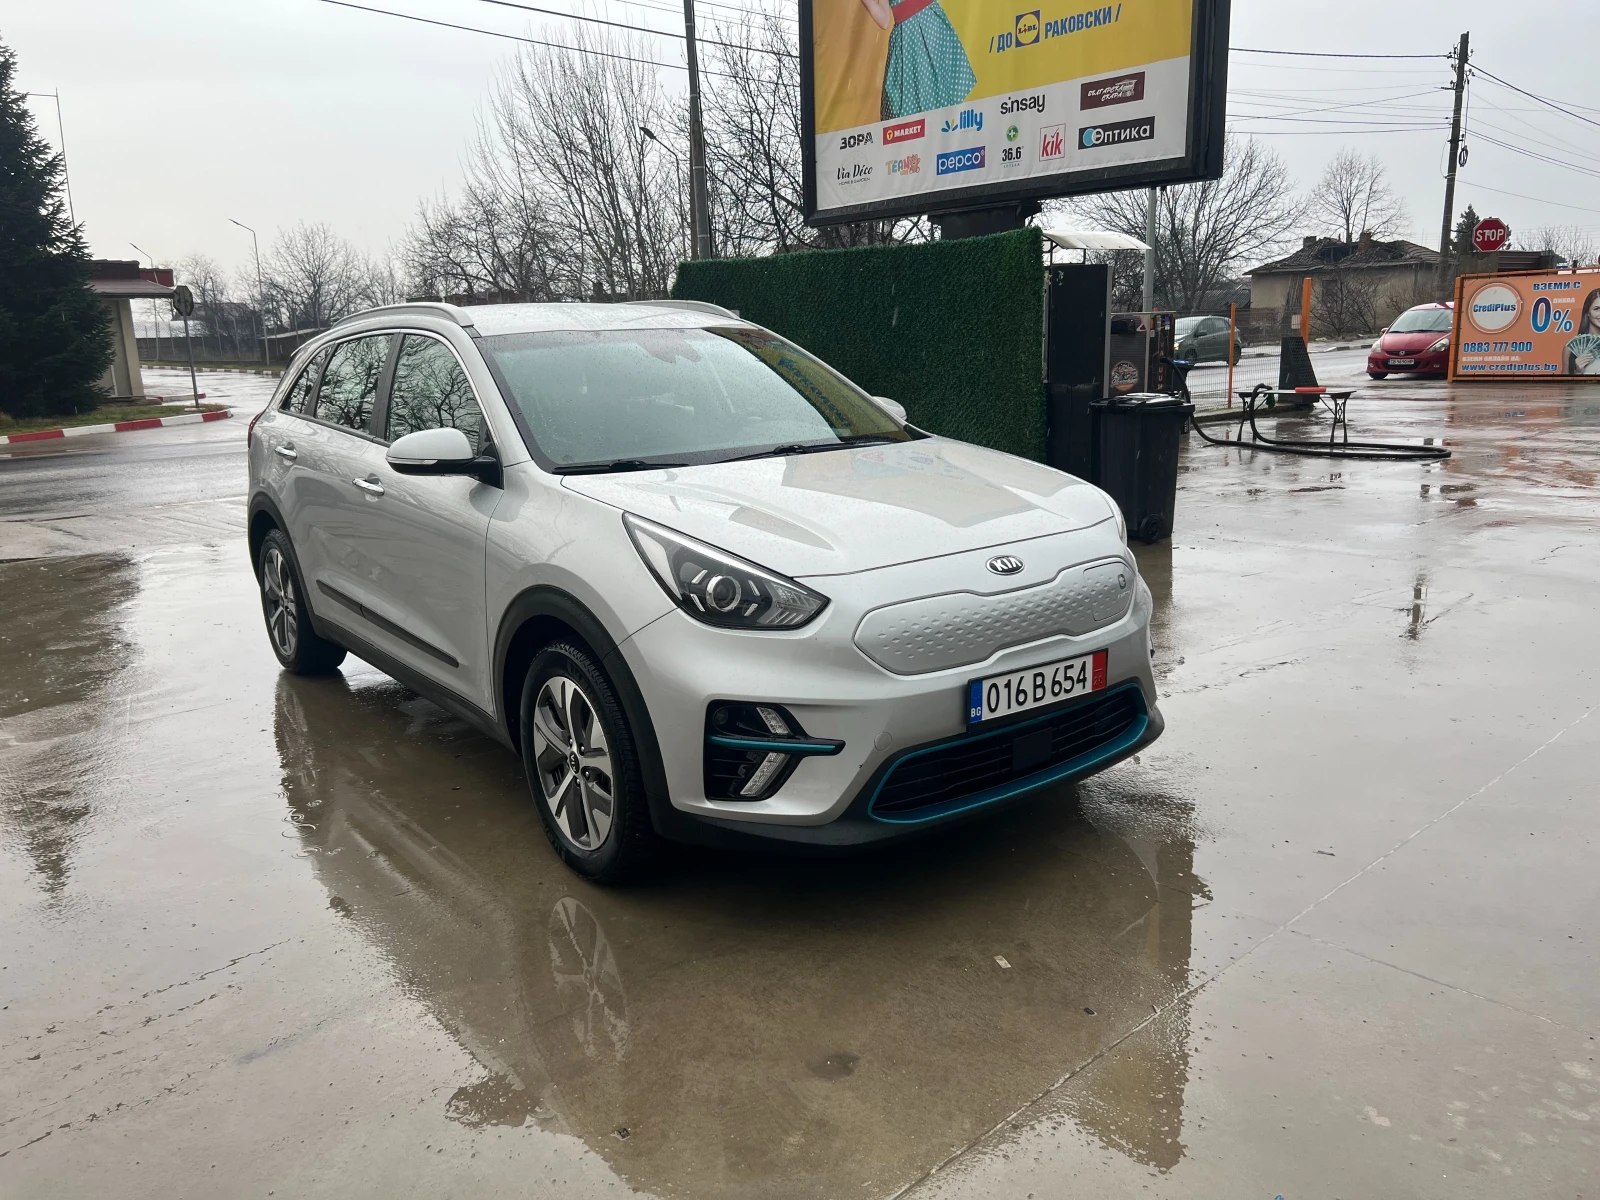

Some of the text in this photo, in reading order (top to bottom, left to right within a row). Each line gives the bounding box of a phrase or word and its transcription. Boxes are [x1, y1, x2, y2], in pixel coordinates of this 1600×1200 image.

[997, 32, 1013, 53] ДО
[1044, 5, 1111, 39] РАКОВСКИ
[1000, 94, 1046, 115] sinsay
[959, 109, 983, 131] lilly
[894, 125, 922, 138] MARKET
[1091, 124, 1150, 144] Оптика
[839, 131, 874, 150] ЗОРА
[837, 167, 851, 180] Via
[1475, 227, 1505, 242] STOP
[1533, 281, 1581, 291] ВЗЕМИ С
[1473, 303, 1517, 313] CrediPlus
[1531, 296, 1574, 333] 0%
[1463, 341, 1533, 353] 0883 777 900
[1461, 363, 1558, 372] www.crediplus.bg
[991, 556, 1022, 572] KIA
[970, 660, 1088, 718] BG 016B654
